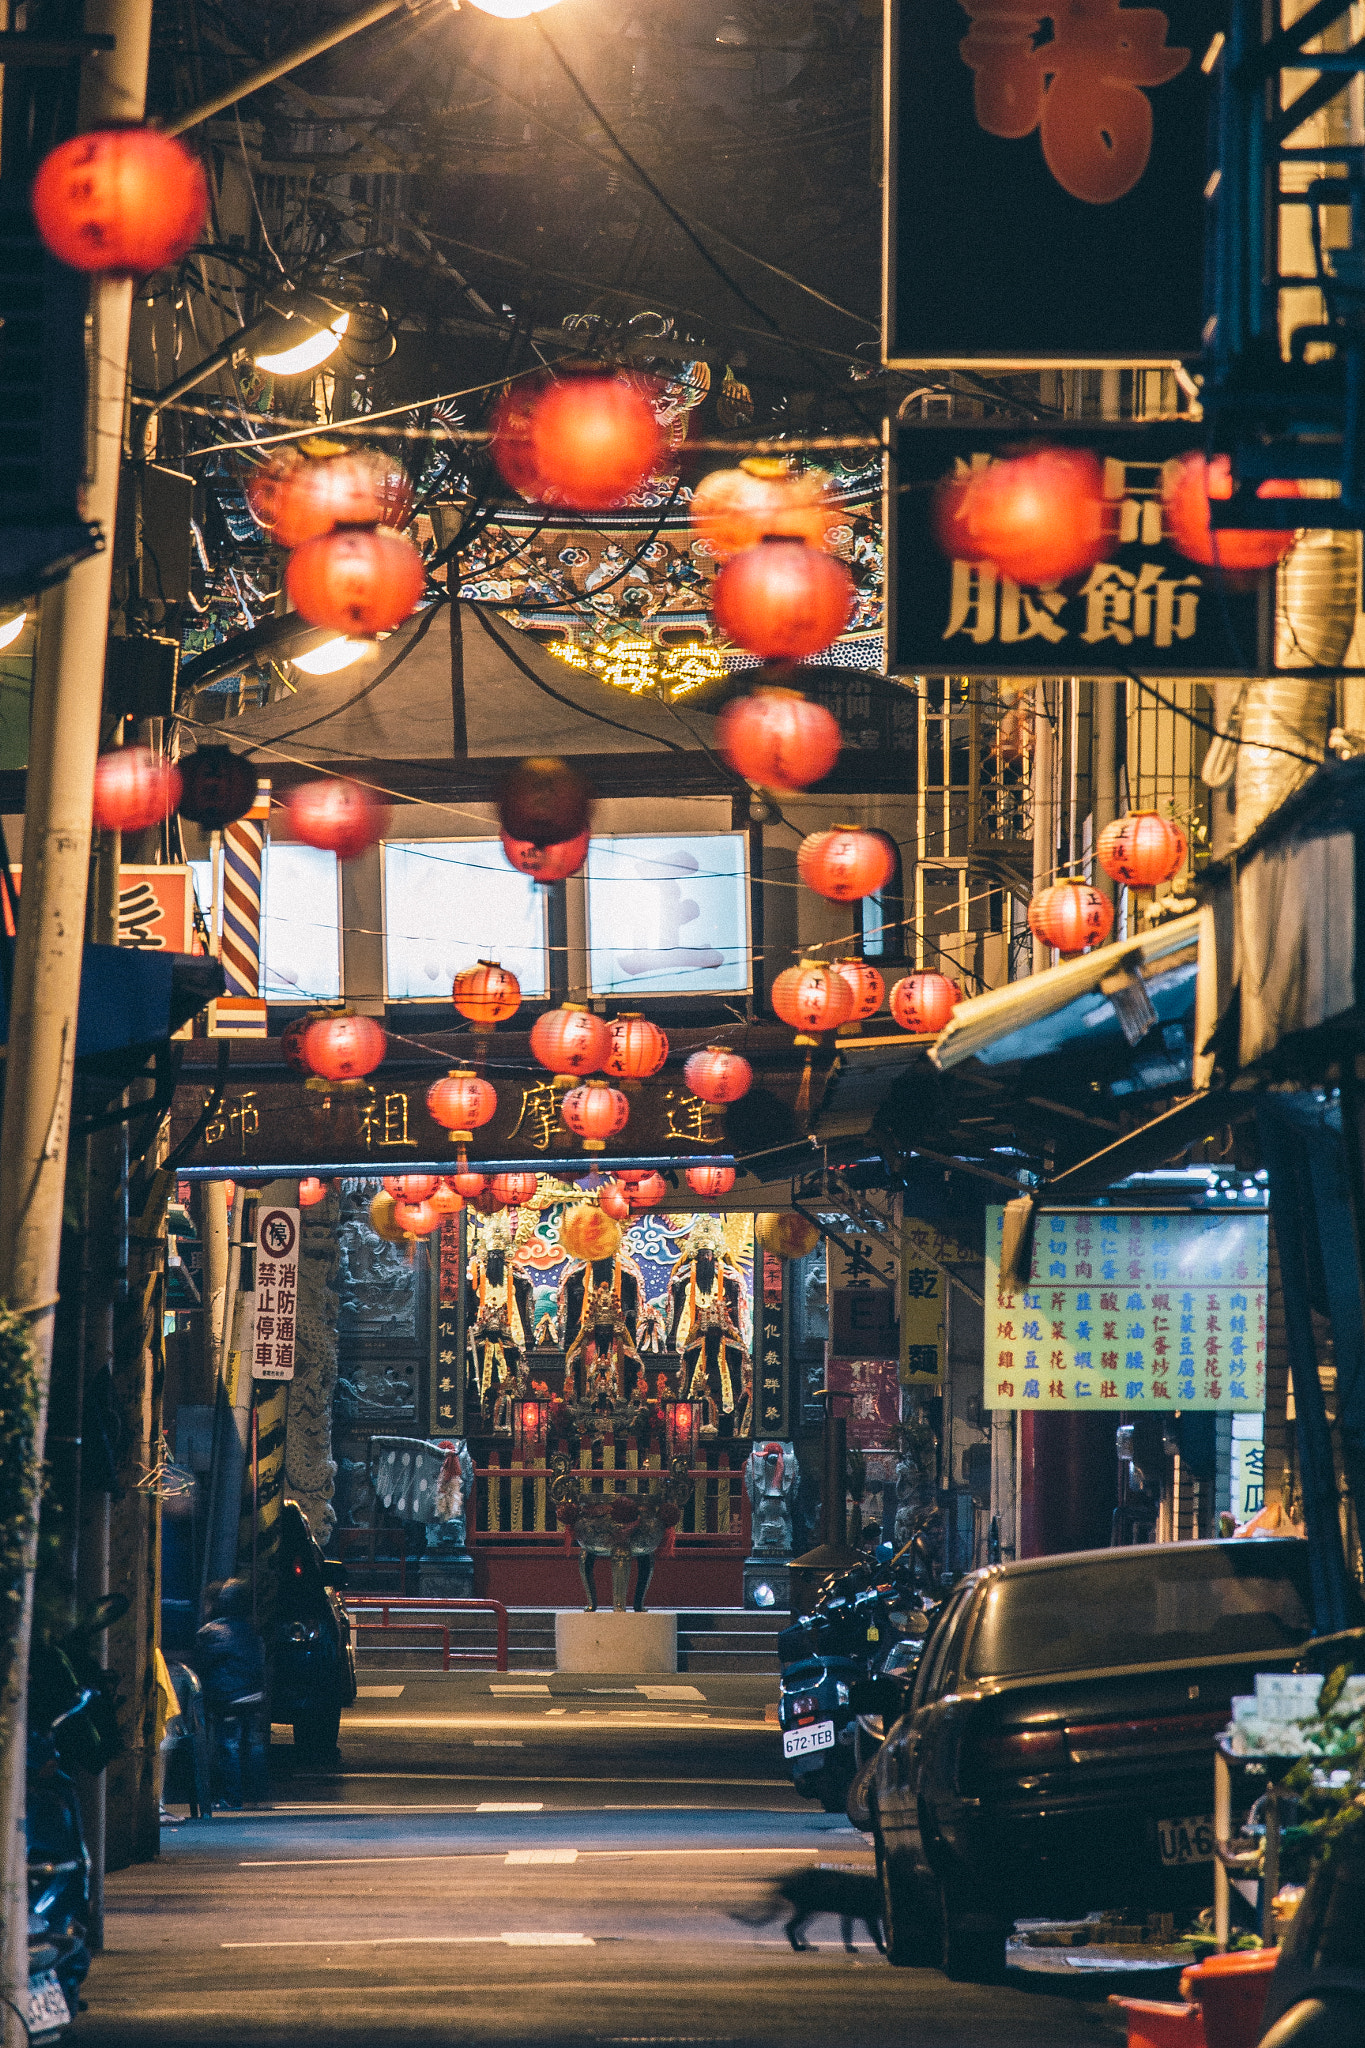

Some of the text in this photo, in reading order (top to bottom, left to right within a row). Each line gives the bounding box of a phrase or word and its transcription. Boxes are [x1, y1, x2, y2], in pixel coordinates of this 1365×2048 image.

[941, 557, 1202, 648] 服飾
[254, 1262, 277, 1367] 禁止停車
[275, 1263, 296, 1368] 消防通道
[997, 1293, 1018, 1398] 紅燒雞肉
[1022, 1292, 1043, 1399] 紅燒豆腐
[1049, 1291, 1067, 1399] 芹菜花枝
[1100, 1292, 1120, 1399] 酸菜豬肚
[1151, 1293, 1172, 1399] 蝦仁蛋炒飯
[1177, 1292, 1196, 1400] 青菜豆腐湯
[1204, 1293, 1222, 1400] 玉米蛋花湯
[1229, 1293, 1249, 1400] 肉絲蛋炒飯
